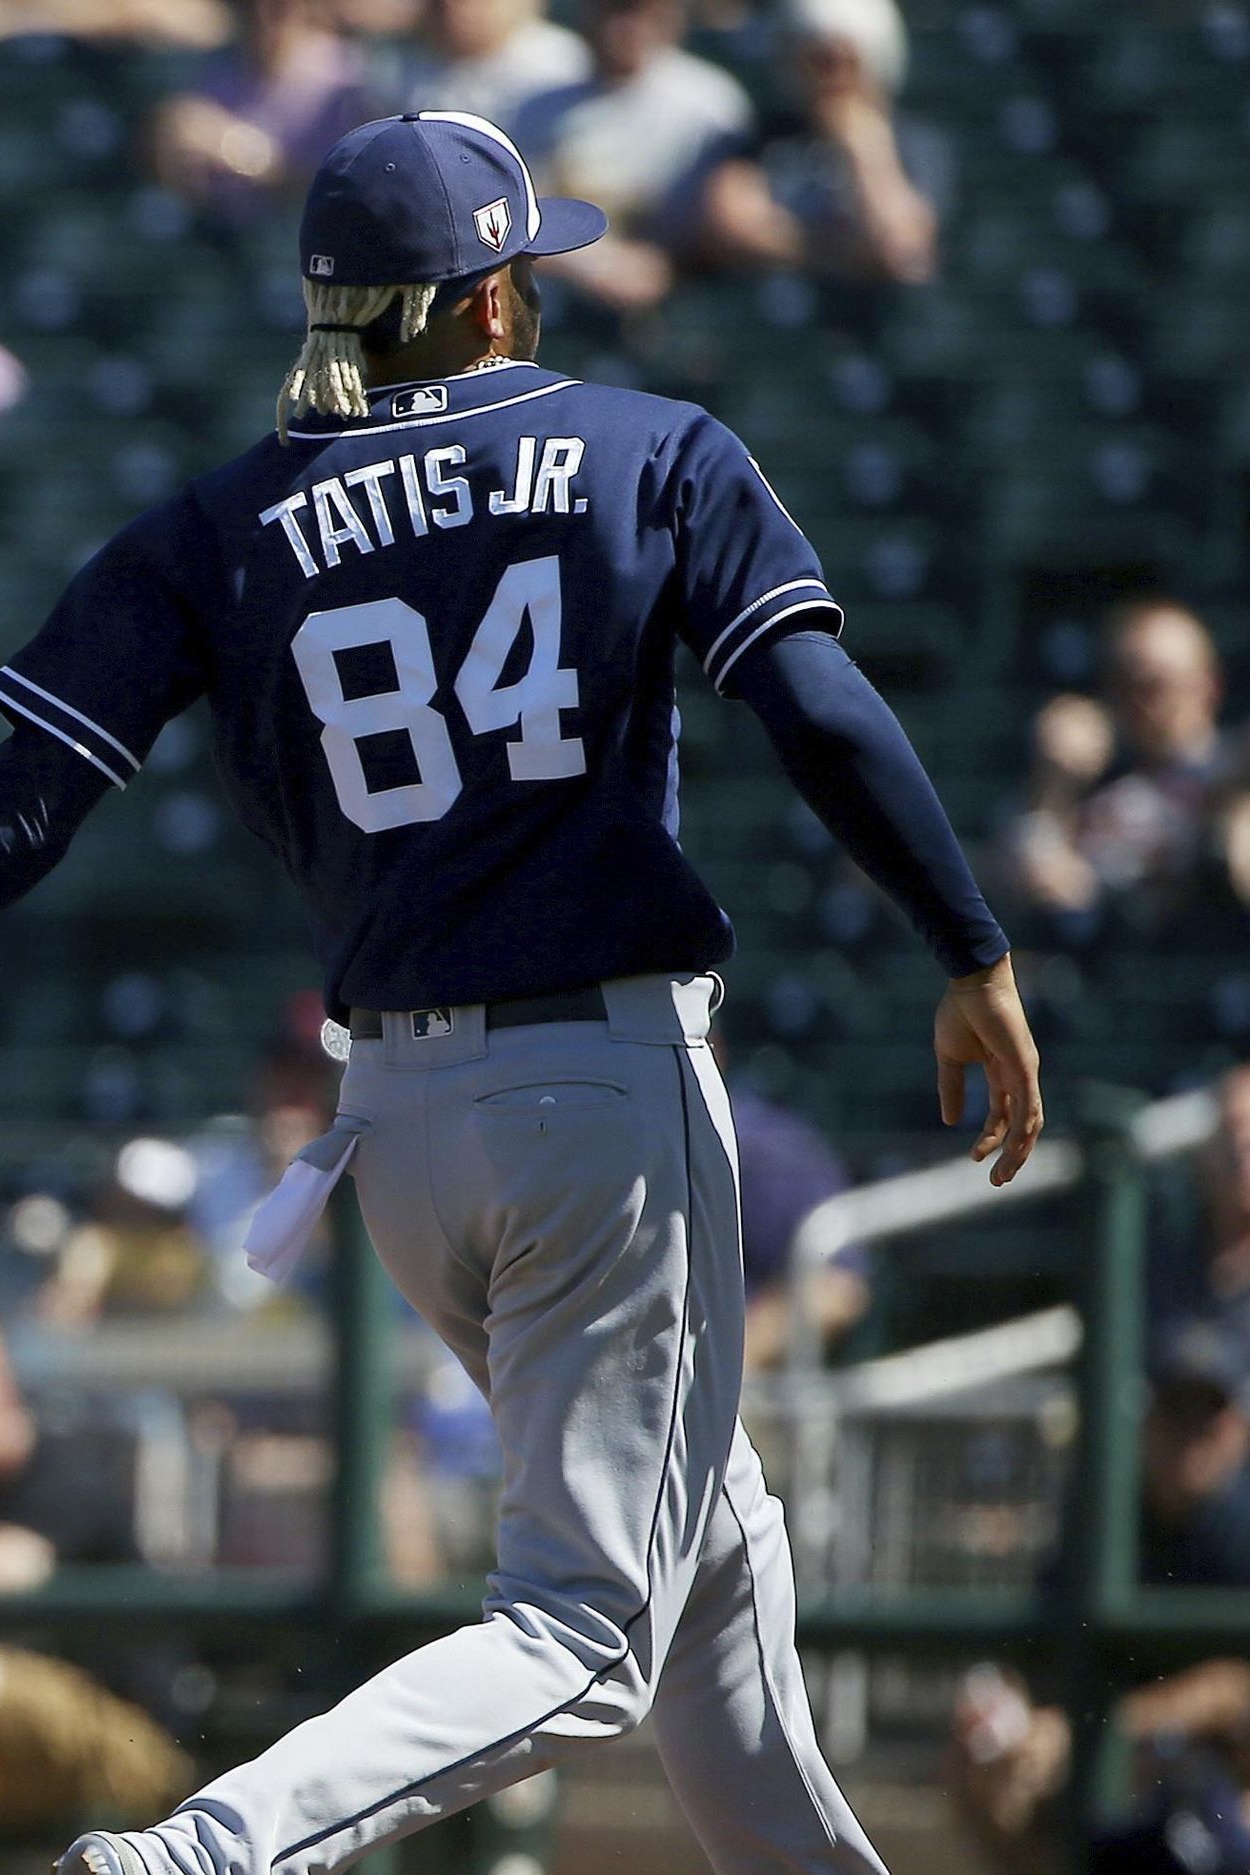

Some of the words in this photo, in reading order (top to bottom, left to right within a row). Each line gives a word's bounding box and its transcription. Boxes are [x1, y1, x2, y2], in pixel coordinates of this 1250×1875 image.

[258, 444, 474, 578] TATIS
[488, 436, 588, 516] JR.
[290, 555, 586, 834] 84
